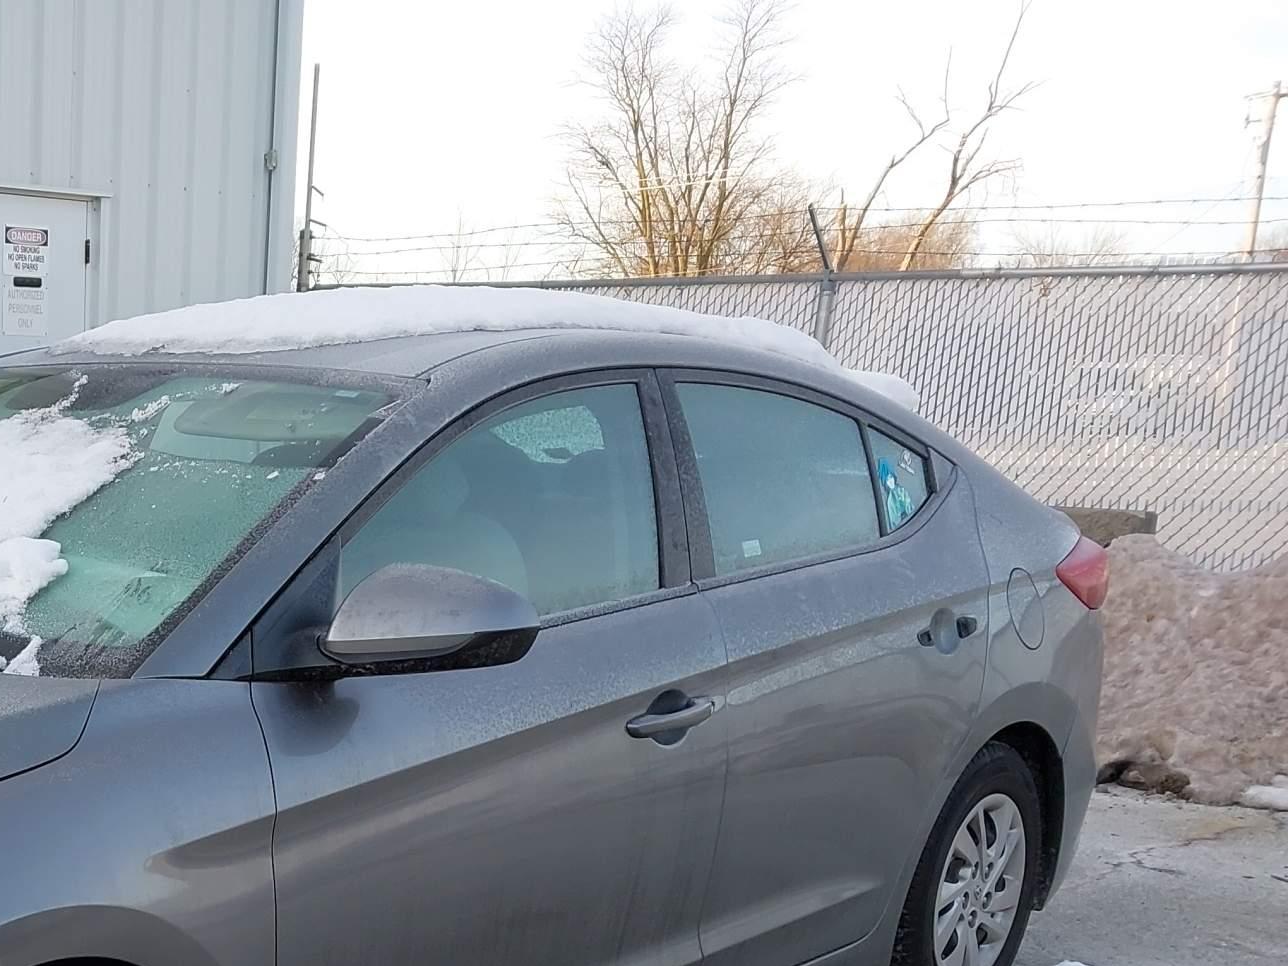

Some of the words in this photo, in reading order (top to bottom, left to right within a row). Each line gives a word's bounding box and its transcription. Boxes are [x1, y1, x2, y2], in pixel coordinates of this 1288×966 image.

[11, 231, 42, 242] DANGER
[21, 246, 40, 254] SMOKING
[8, 253, 14, 261] NO
[15, 254, 27, 262] OPEN
[14, 262, 20, 270] NO
[22, 263, 38, 271] SPARKS
[7, 289, 44, 300] AUTHORIZED
[8, 303, 43, 314] PERSONNEL
[17, 318, 33, 328] ONLY
